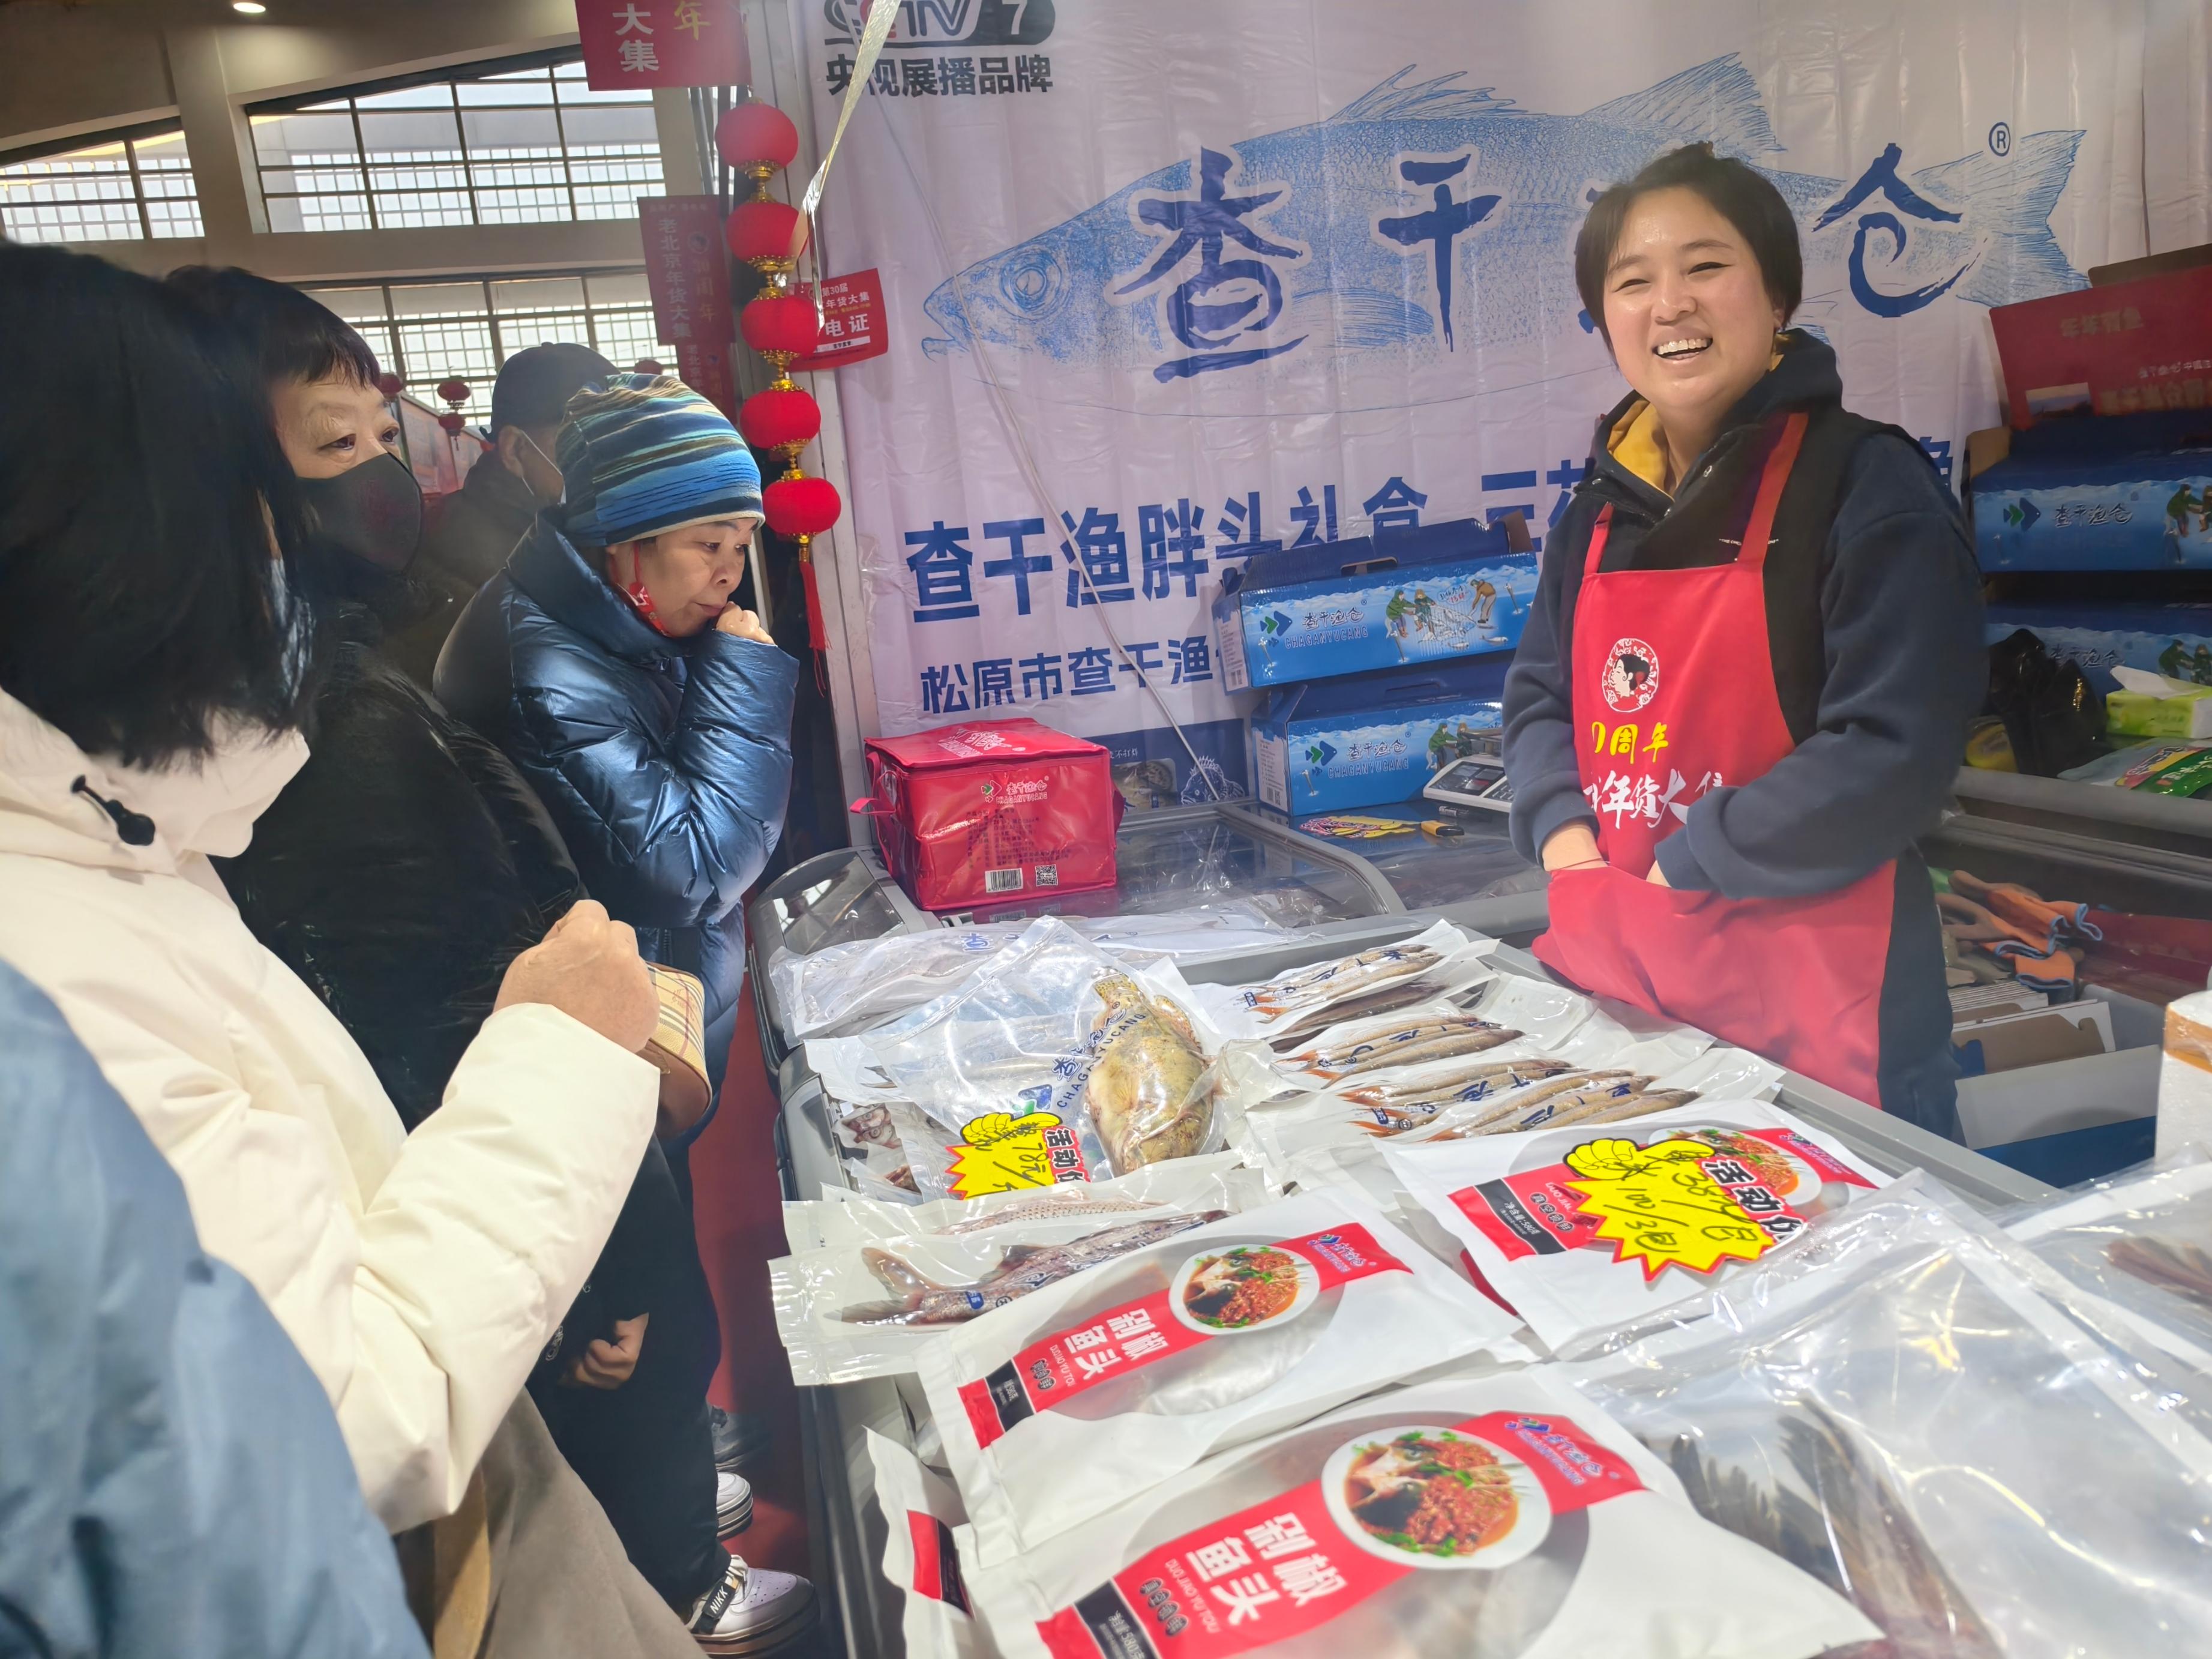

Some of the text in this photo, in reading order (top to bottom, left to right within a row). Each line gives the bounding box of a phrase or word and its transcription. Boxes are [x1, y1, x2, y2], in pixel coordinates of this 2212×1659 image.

[823, 0, 971, 38] CTV
[612, 3, 660, 72] 大集
[826, 53, 1053, 97] 央视展播品牌
[823, 292, 870, 309] 年货大集
[1302, 607, 1365, 631] 查干渔仓
[1285, 625, 1368, 649] CHAGANYUCANG
[921, 635, 1218, 714] 松原市查干渔
[1347, 739, 1407, 762] 查干渔仓
[1328, 758, 1409, 778] CHAGANYUCANG
[1063, 1325, 1122, 1380] 鱼头
[1164, 1558, 1185, 1579] DUO
[1243, 1512, 1348, 1607] 剁椒
[1186, 1536, 1281, 1625] 鱼头
[709, 1586, 729, 1614] NIKK
